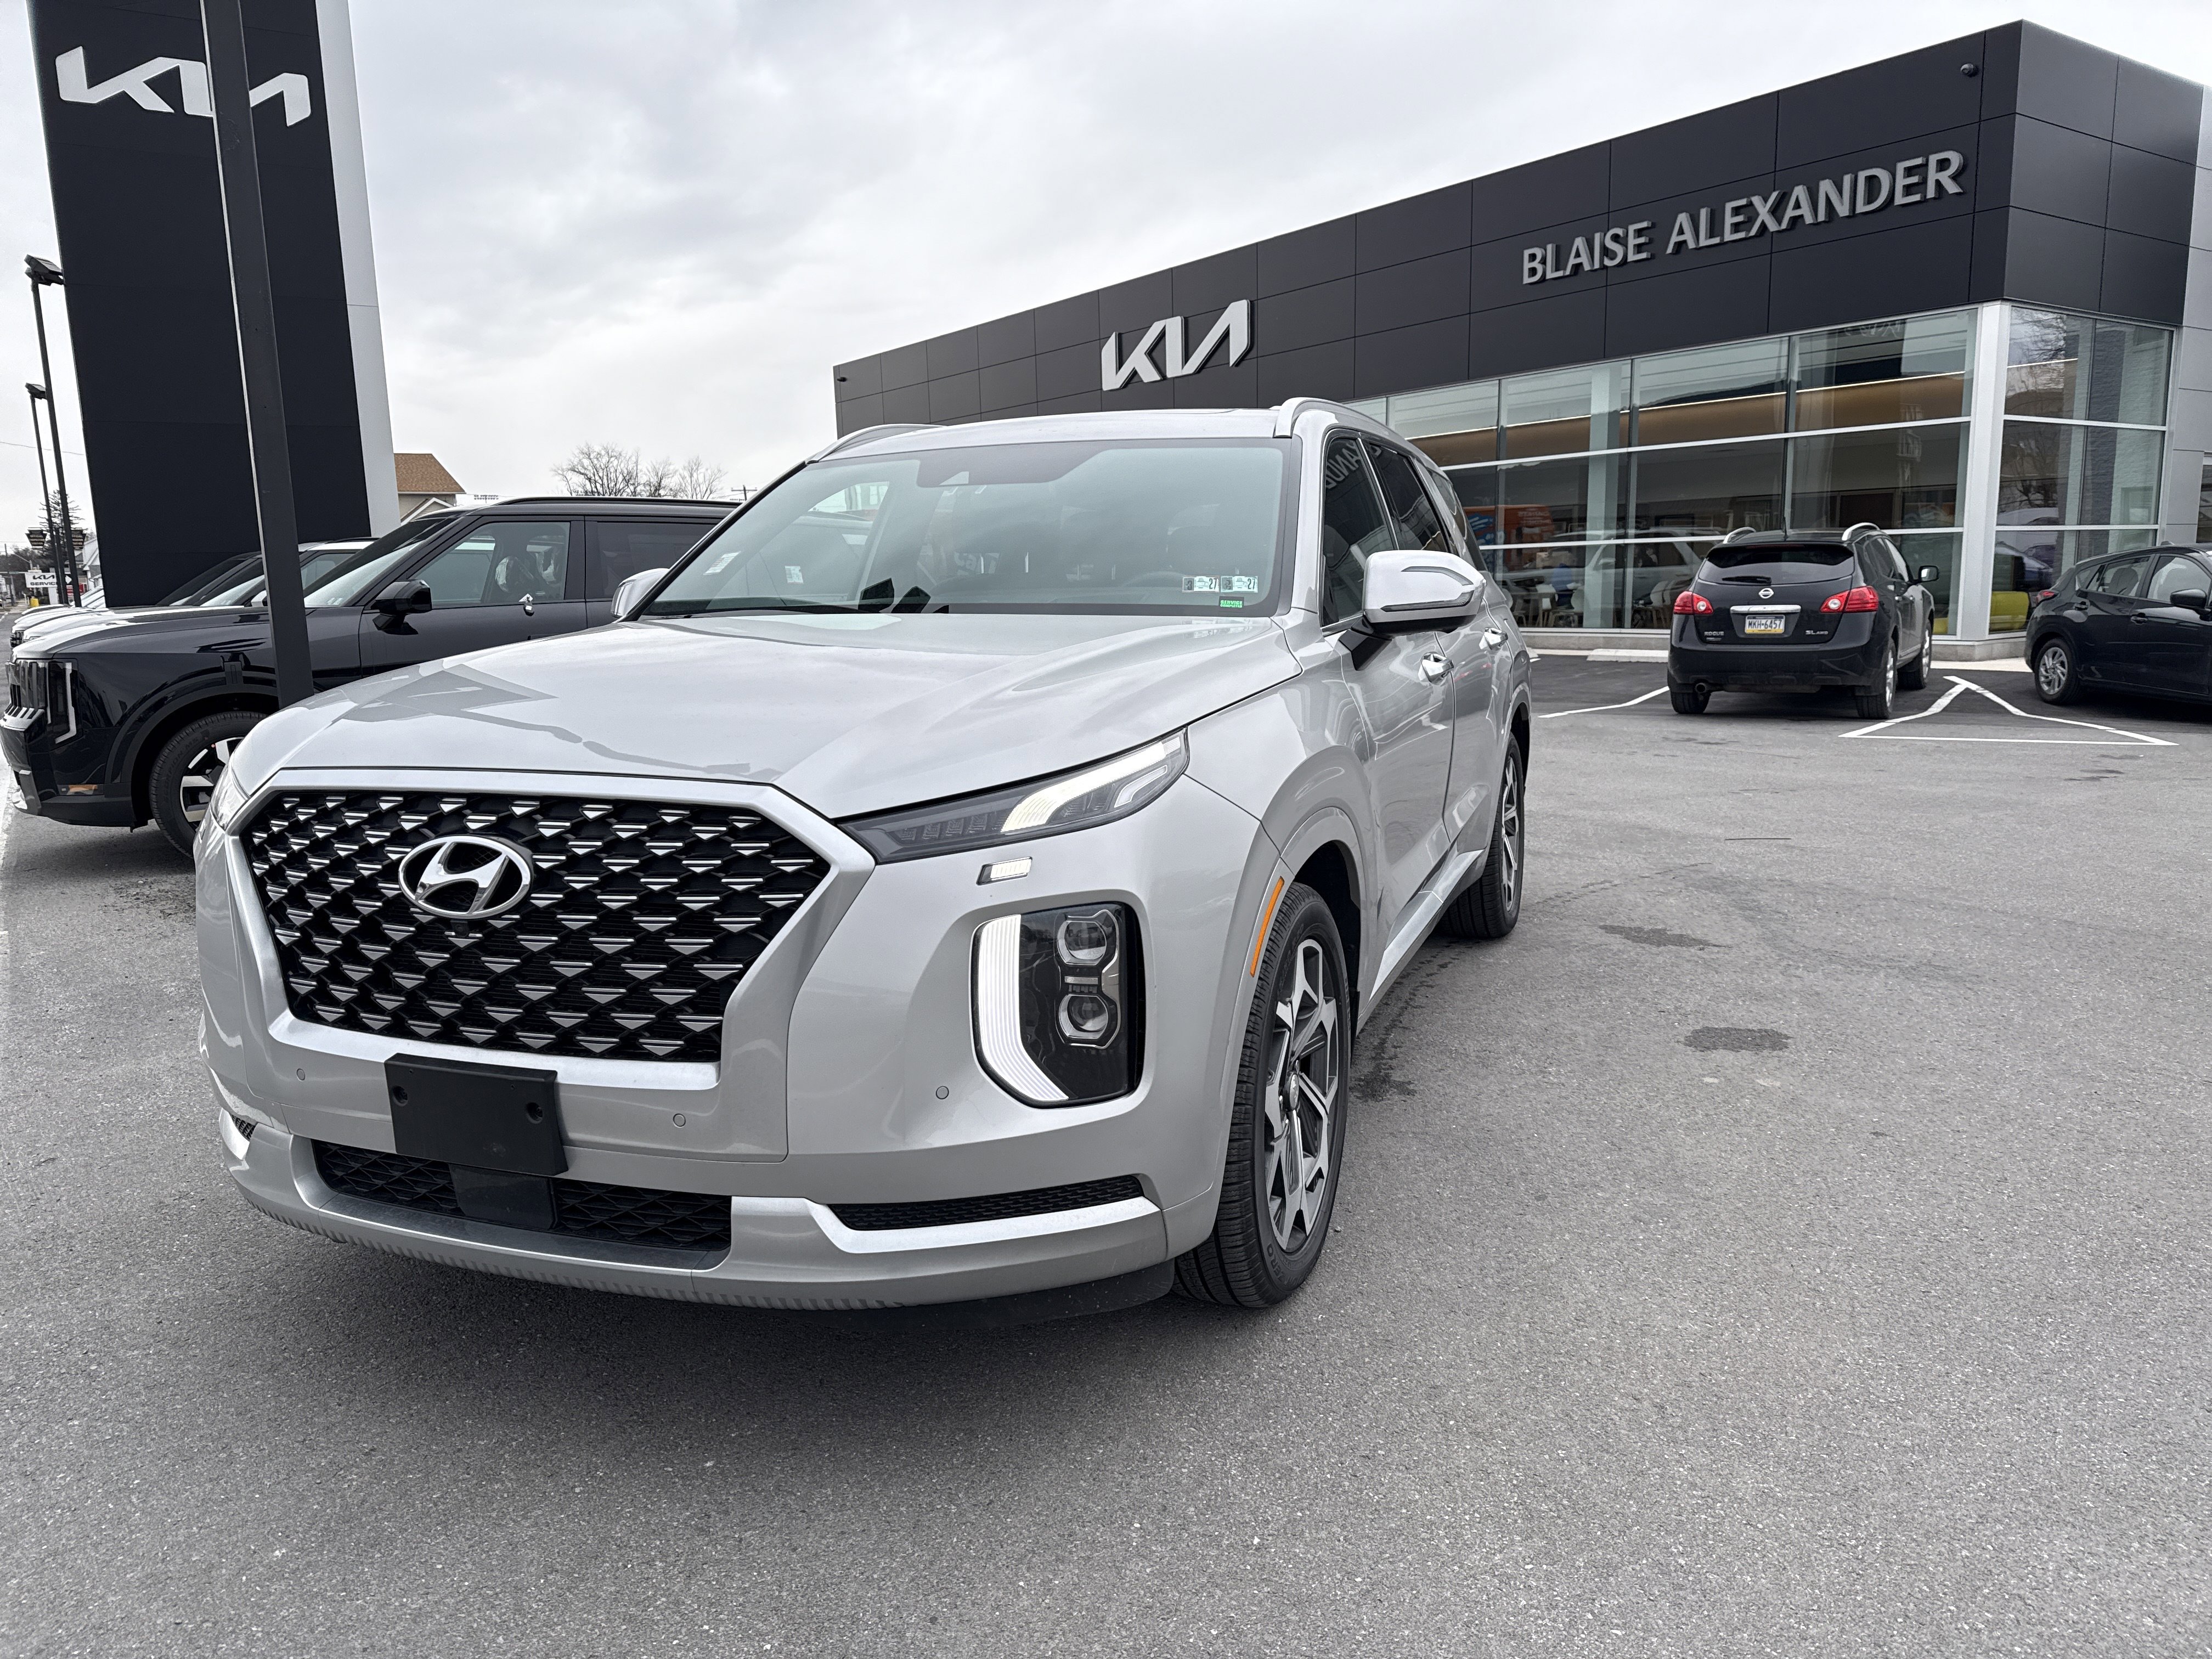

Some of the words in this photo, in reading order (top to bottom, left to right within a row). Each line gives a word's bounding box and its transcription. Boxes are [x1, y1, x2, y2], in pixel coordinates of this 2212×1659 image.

[55, 46, 312, 127] KIA
[1522, 221, 1654, 285] BLAISE
[1666, 150, 1965, 254] ALEXANDER
[1101, 299, 1251, 392] KIA
[1209, 578, 1217, 590] 27
[1247, 578, 1255, 590] 27
